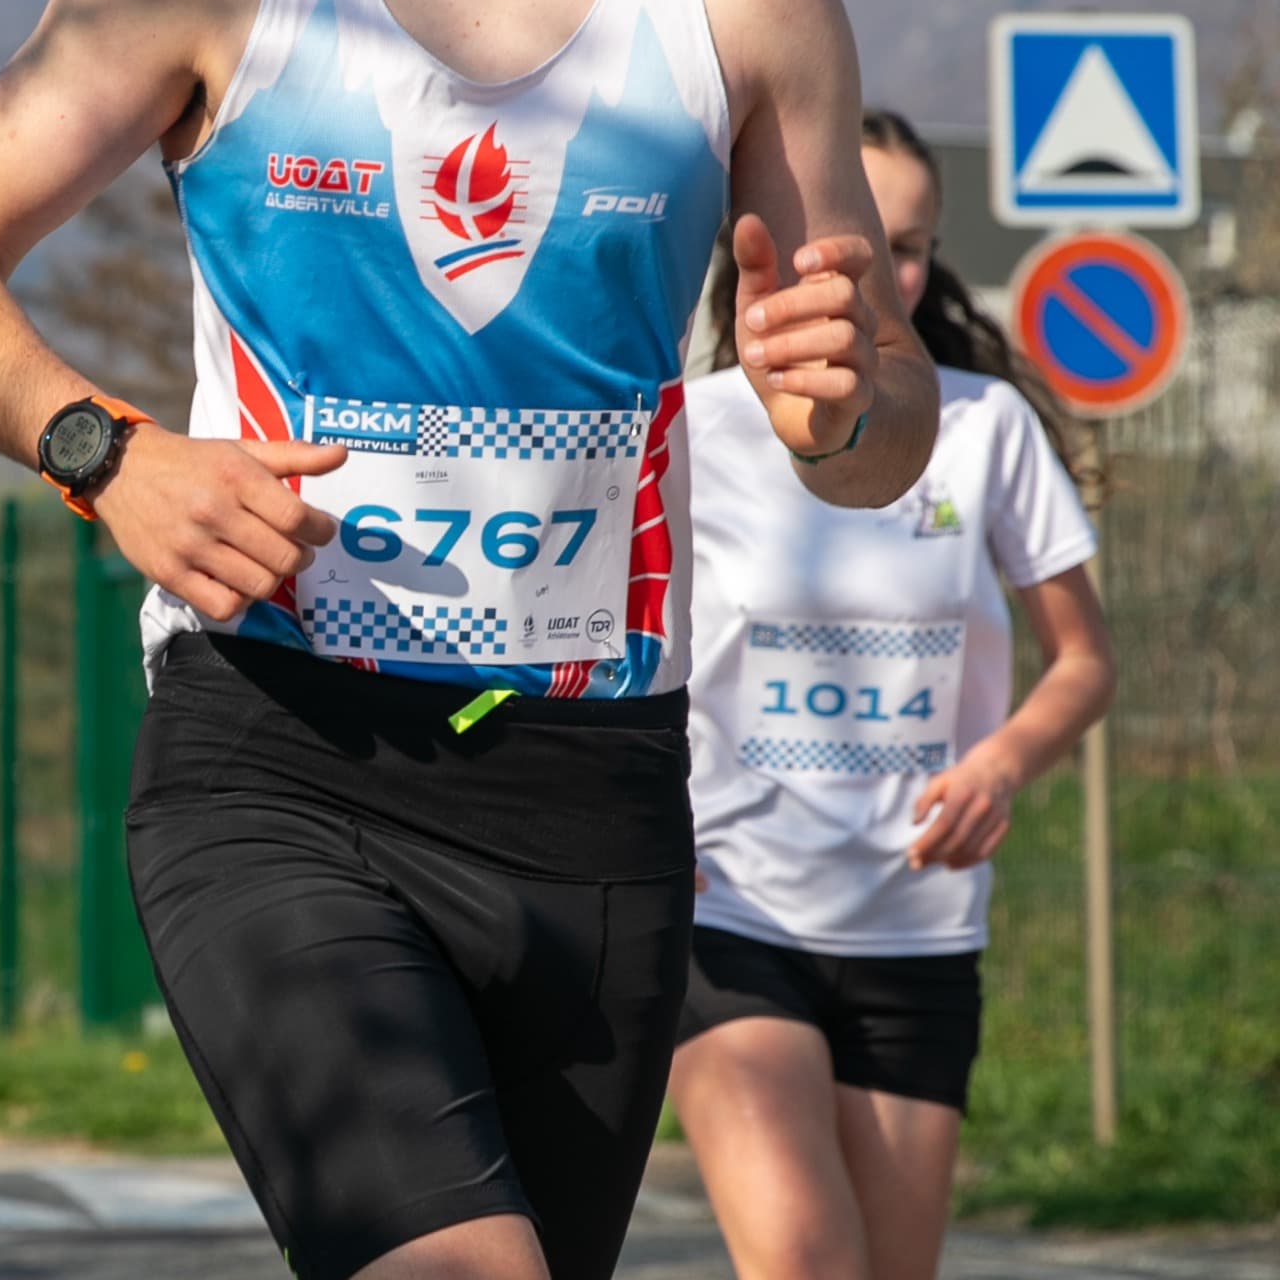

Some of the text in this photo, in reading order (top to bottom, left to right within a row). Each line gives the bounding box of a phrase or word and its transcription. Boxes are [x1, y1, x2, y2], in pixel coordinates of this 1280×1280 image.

[267, 152, 384, 195] UOAT
[265, 192, 390, 218] ALBERTVILLE
[582, 192, 669, 217] poli
[318, 407, 411, 433] 10KM
[339, 504, 598, 569] 6767
[590, 620, 611, 633] TDR
[761, 679, 937, 722] 1014
